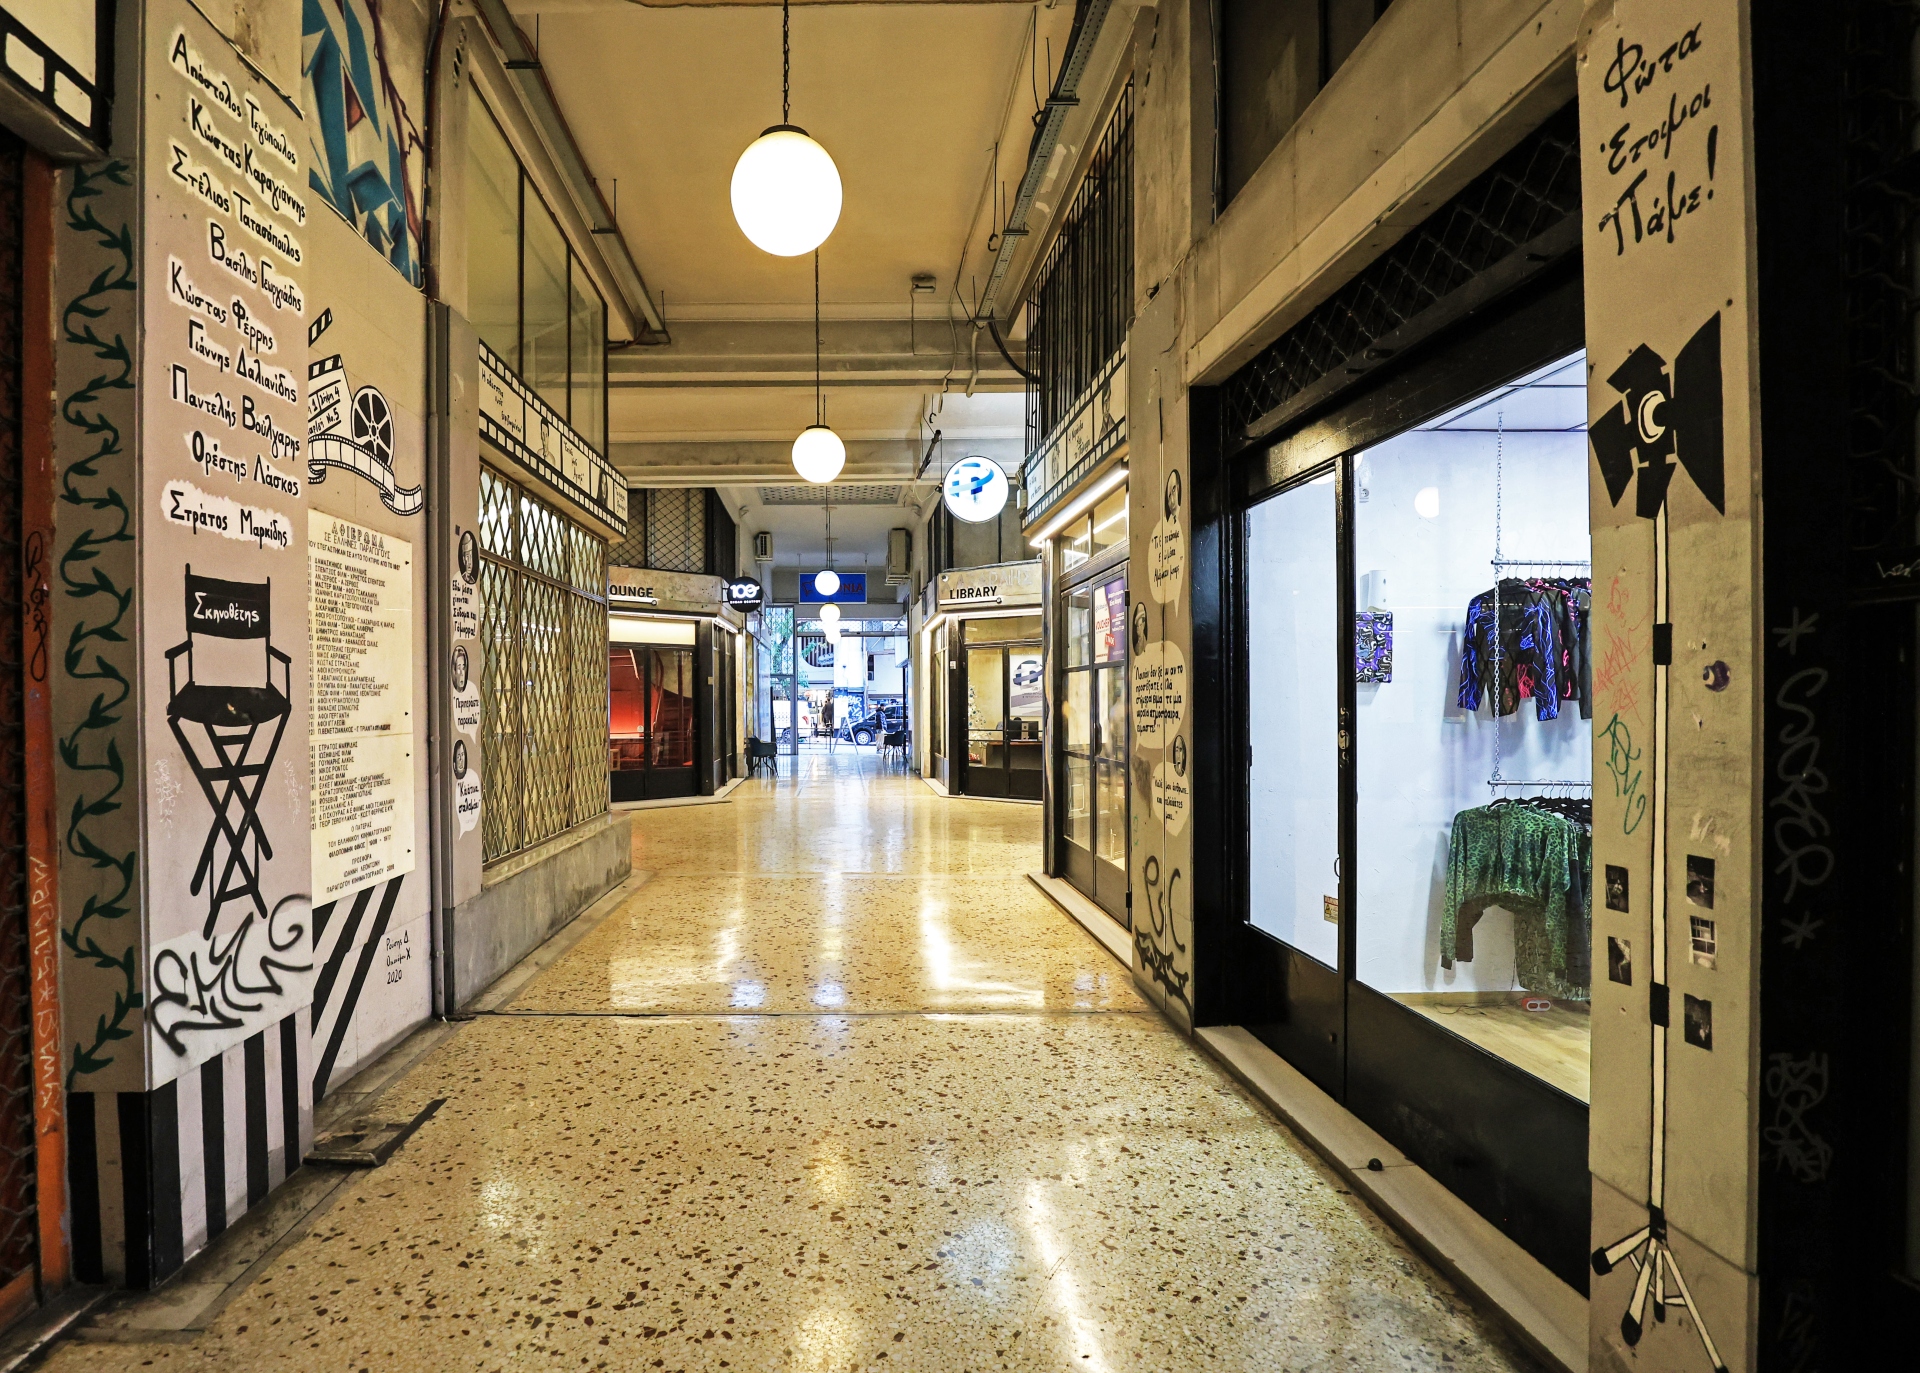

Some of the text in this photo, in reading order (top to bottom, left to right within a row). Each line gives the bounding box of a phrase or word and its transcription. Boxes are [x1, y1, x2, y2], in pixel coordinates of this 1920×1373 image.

[1603, 21, 1702, 108] Φώτα
[172, 32, 297, 165] Απόστολος Τεγόπουλος
[191, 97, 306, 219] Κώστας Καραγιάννης
[1598, 124, 1719, 257] Πάμε!
[171, 145, 301, 263] Στέλιος Τατασόπουλος
[210, 222, 302, 312] Βασίλης Γεωργιάδης
[171, 261, 274, 353] Κώστας Φέρρης
[188, 319, 297, 403] Γιάννης Δαλιανίδης
[171, 364, 300, 461] Παντελής Βούλγαρης
[192, 430, 299, 497] Ορέστης Λάσκος
[170, 489, 288, 549] Στράτος Μαρκίδης
[324, 531, 390, 560] ΣΕ ΕΛΛΗΝΕΣ ΠΑΡΑΓΩΓΟΥΣ
[331, 521, 385, 550] ΑΦΙΕΡΩΜΑ
[315, 557, 342, 570] ΔΑΜΑΣΚΗΝΟΣ
[317, 542, 346, 556] ΣΤΕΓΑΣΤΗΚΑΝ
[347, 550, 352, 558] ΣΕ
[352, 551, 362, 561] ΑΥΤΟ
[363, 554, 368, 563] ΤΟ
[315, 580, 331, 589] ΜΑΣΤΕΡ
[609, 584, 654, 598] OUNGE
[729, 583, 760, 599] 100
[949, 585, 997, 600] LIBRARY
[193, 591, 260, 628] Σκηνοθέτης
[315, 596, 327, 604] ΚΛΑΚ
[316, 644, 367, 655] ΑΡΙΣΤΟΤΕΛΗΣ ΓΕΩΡΓΙΑΔΗΣ
[319, 742, 338, 752] ΣΤΡΑΤΟΣ
[337, 834, 359, 845] ΕΛΛΗΝΙΚΟΥ
[360, 826, 392, 839] ΚΙΝΗΜΑΤΟΓΡΑΦΟΥ
[355, 821, 372, 830] ΠΑΤΕΡΑΣ
[352, 853, 372, 865] ΠΡΟΣΦΟΡΑ
[326, 869, 384, 893] ΠΑΡΑΓΩΓΟΥ ΚΙΝΗΜΑΤΟΓΡΑΦΟΥ
[386, 968, 403, 985] 2020
